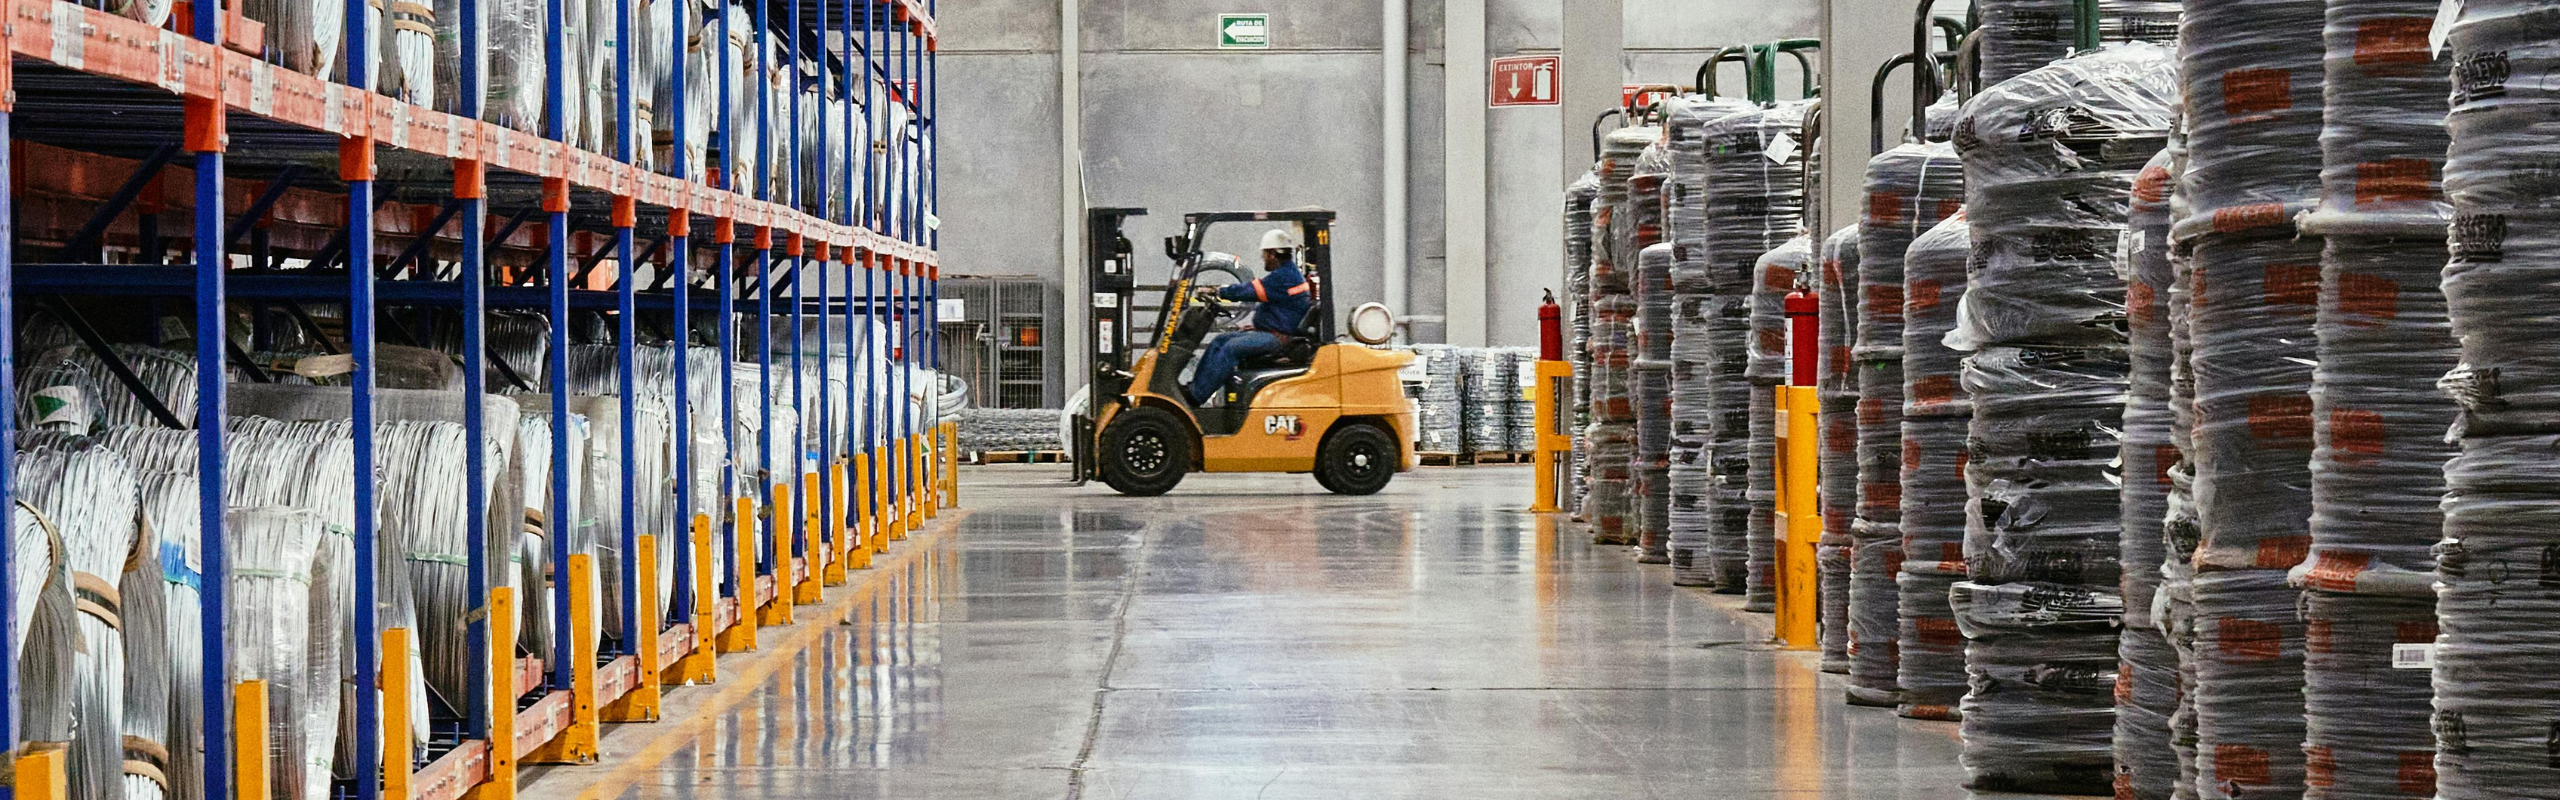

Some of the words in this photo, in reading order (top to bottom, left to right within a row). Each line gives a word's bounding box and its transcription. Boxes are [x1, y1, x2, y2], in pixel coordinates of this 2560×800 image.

[1499, 62, 1534, 71] EXTINTOR
[1317, 230, 1328, 245] 11
[1264, 415, 1298, 435] CAT
